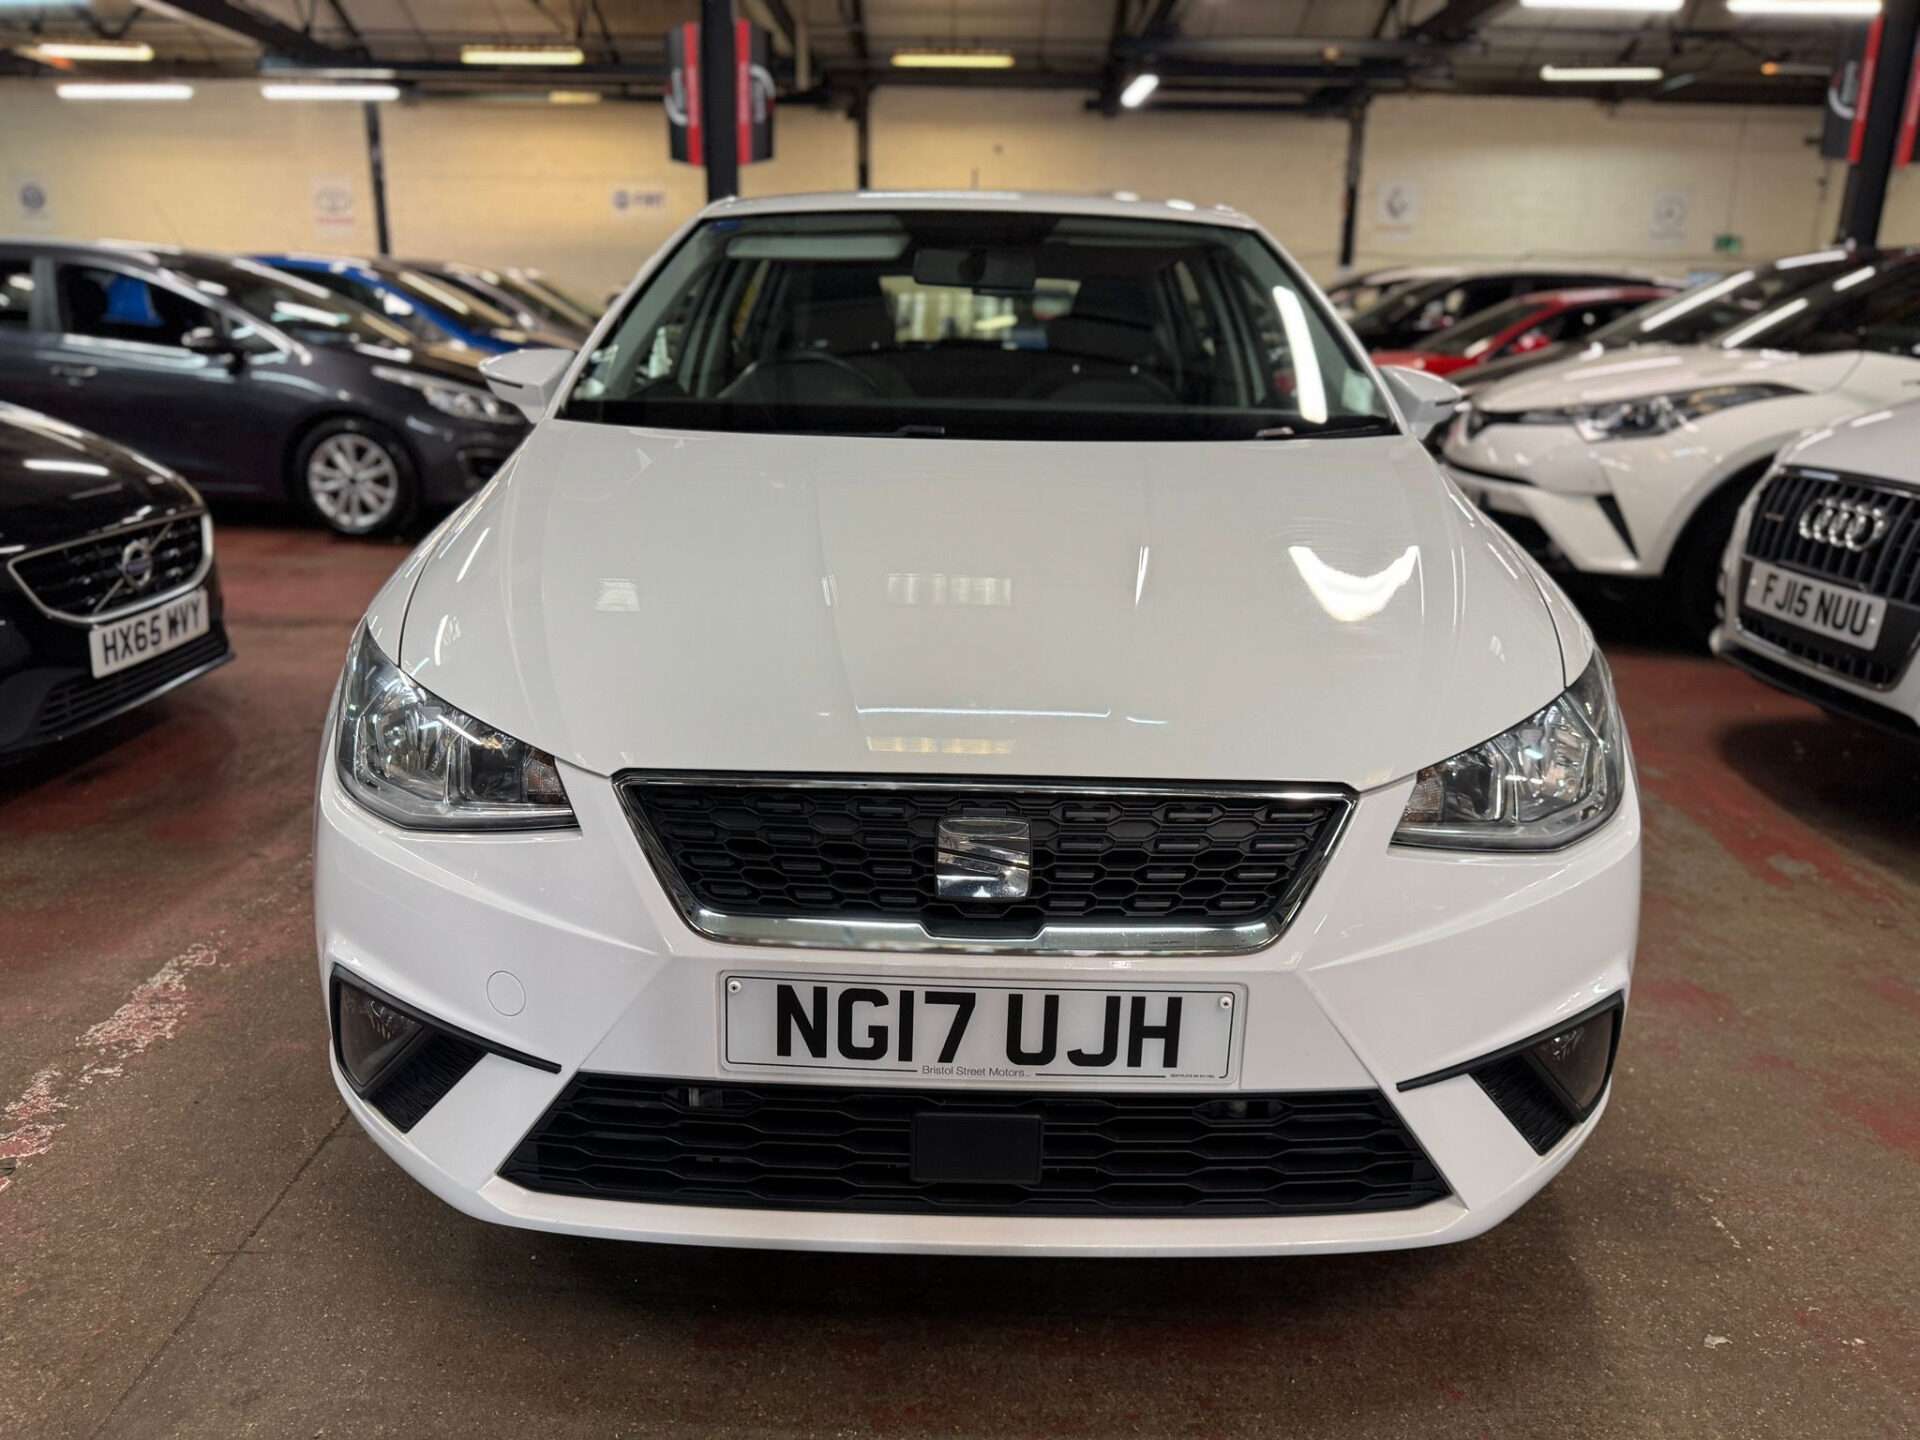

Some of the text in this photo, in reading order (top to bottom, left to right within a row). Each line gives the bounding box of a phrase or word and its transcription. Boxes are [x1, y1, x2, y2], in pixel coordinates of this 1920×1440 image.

[1762, 573, 1872, 635] FJ15 NUU
[102, 614, 162, 665] HX65
[776, 984, 1183, 1068] NG17 UJH
[922, 1064, 1025, 1078] Bristol Street Motors
